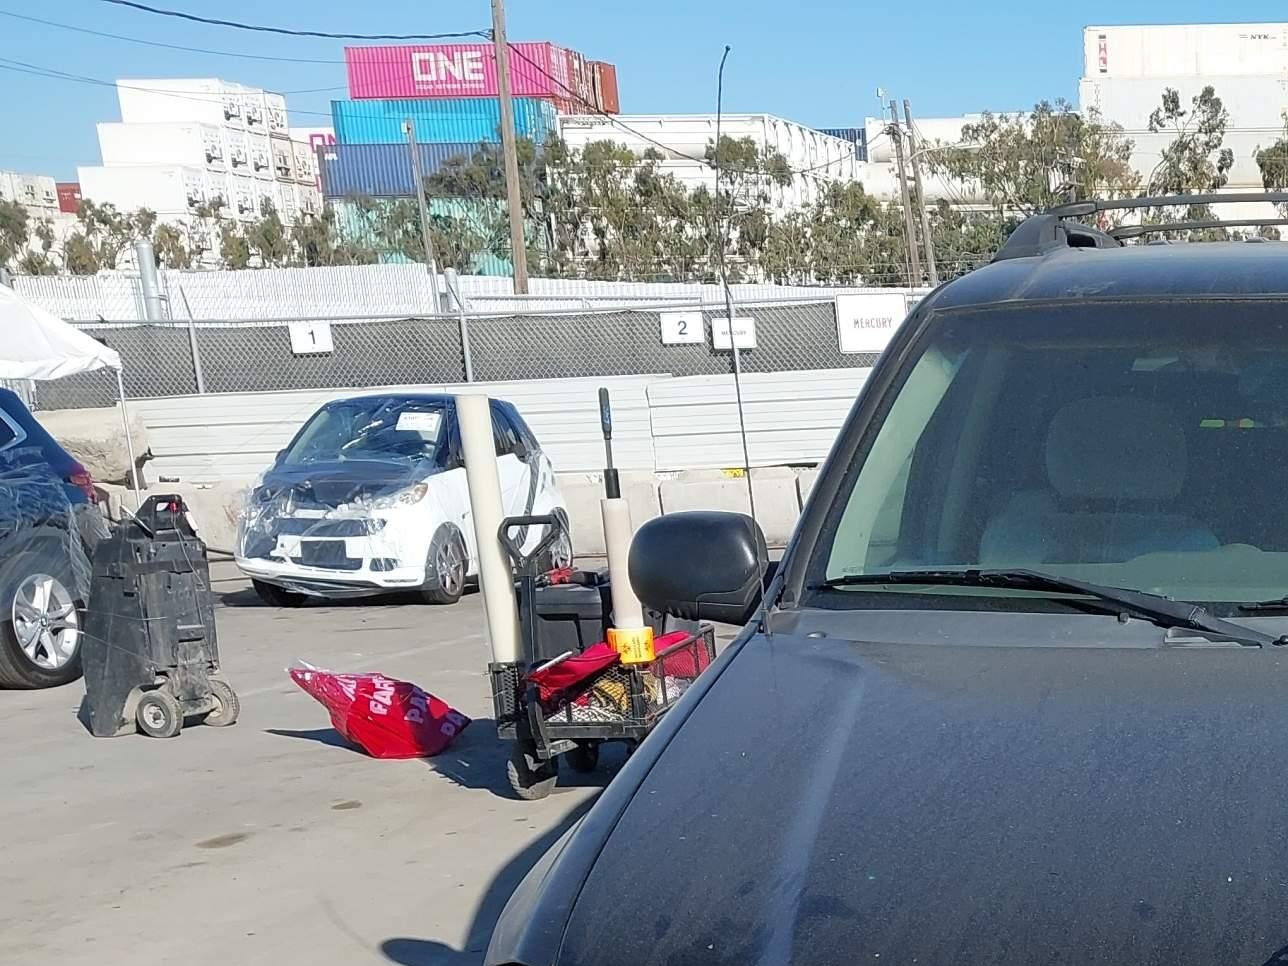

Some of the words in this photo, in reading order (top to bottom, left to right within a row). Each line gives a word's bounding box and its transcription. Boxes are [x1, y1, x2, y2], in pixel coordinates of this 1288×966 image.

[411, 51, 485, 81] ONE
[677, 320, 689, 336] 2
[853, 316, 893, 329] MERCURY
[308, 329, 316, 345] 1
